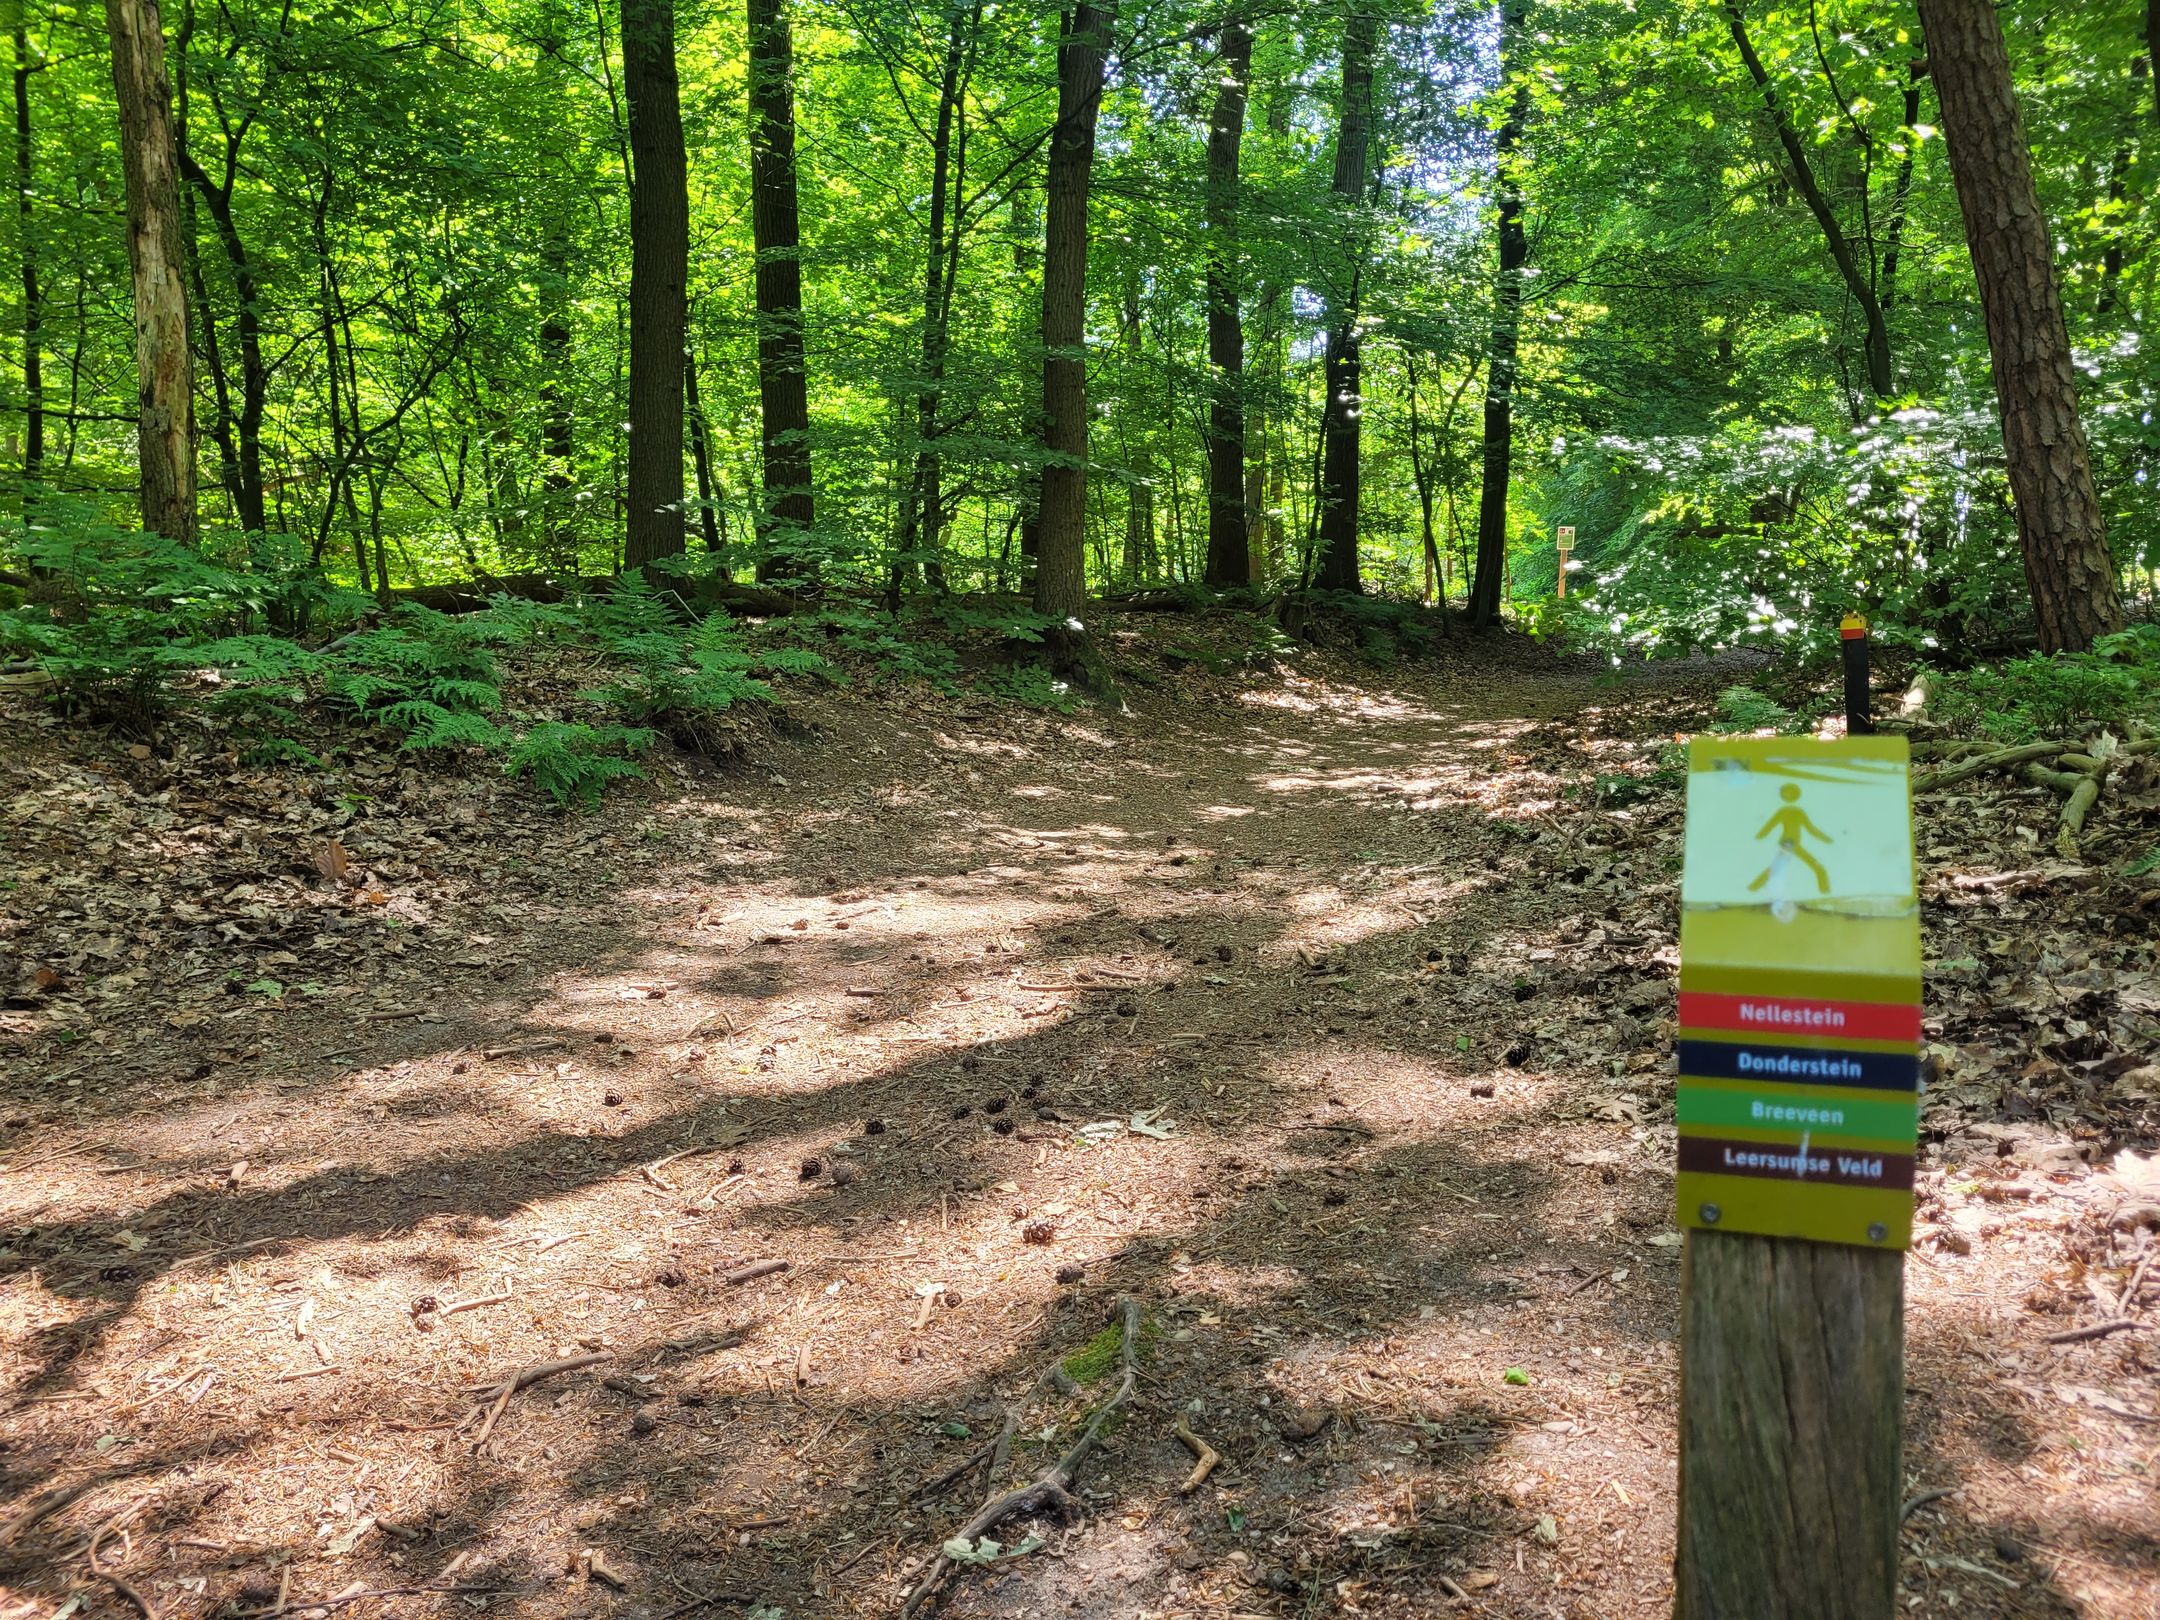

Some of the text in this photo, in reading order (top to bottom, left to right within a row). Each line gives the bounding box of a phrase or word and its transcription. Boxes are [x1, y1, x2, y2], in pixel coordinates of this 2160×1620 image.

[1740, 1004, 1845, 1026] Nellestein
[1738, 1053, 1862, 1077] Donderstein
[1751, 1102, 1843, 1124] Breeveen
[1838, 1157, 1883, 1177] Veld
